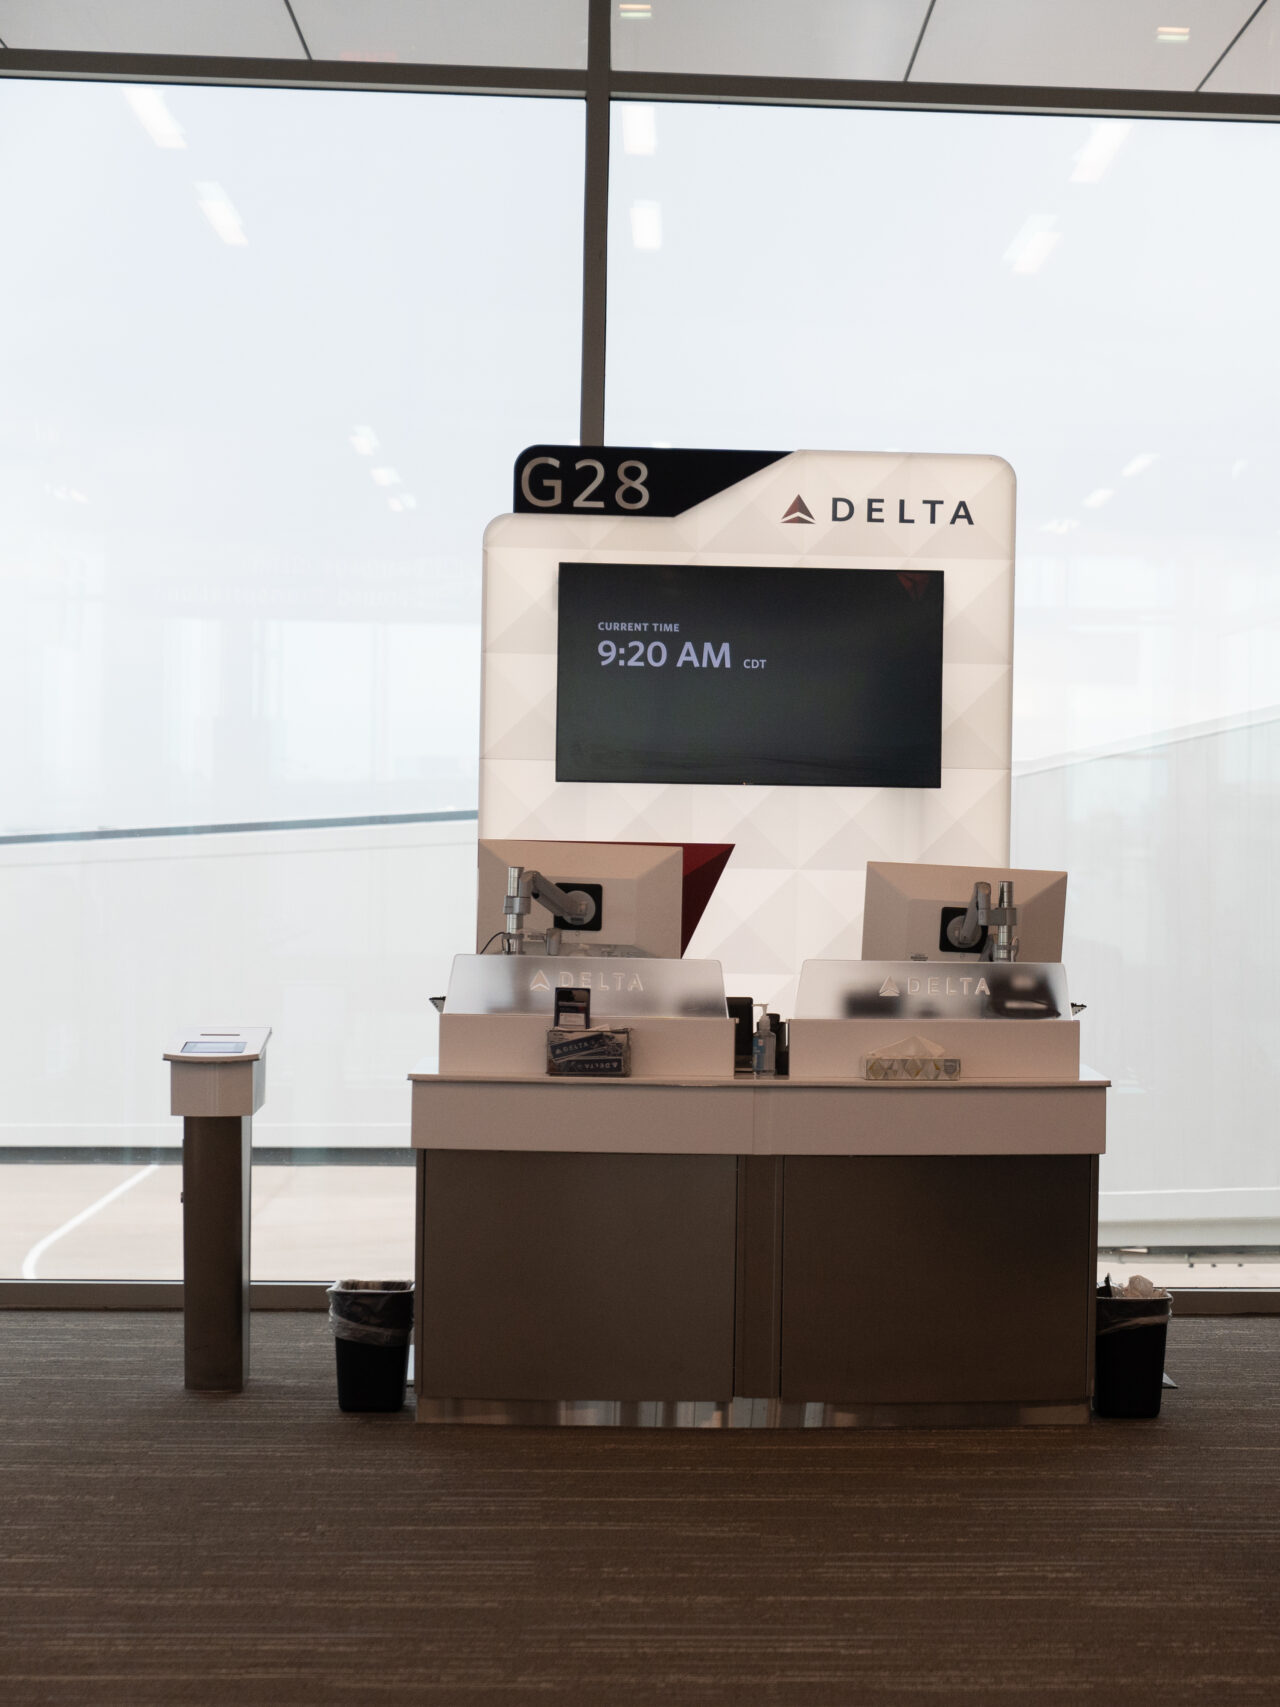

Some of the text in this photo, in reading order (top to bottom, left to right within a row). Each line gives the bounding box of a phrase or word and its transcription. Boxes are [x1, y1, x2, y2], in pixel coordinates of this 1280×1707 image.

[520, 457, 650, 510] G28
[831, 497, 975, 526] DELTA
[597, 621, 680, 633] CURRENT TIME
[597, 640, 767, 670] 9:20 AM CDT
[558, 971, 644, 991] DELTA
[906, 976, 991, 996] DELTA
